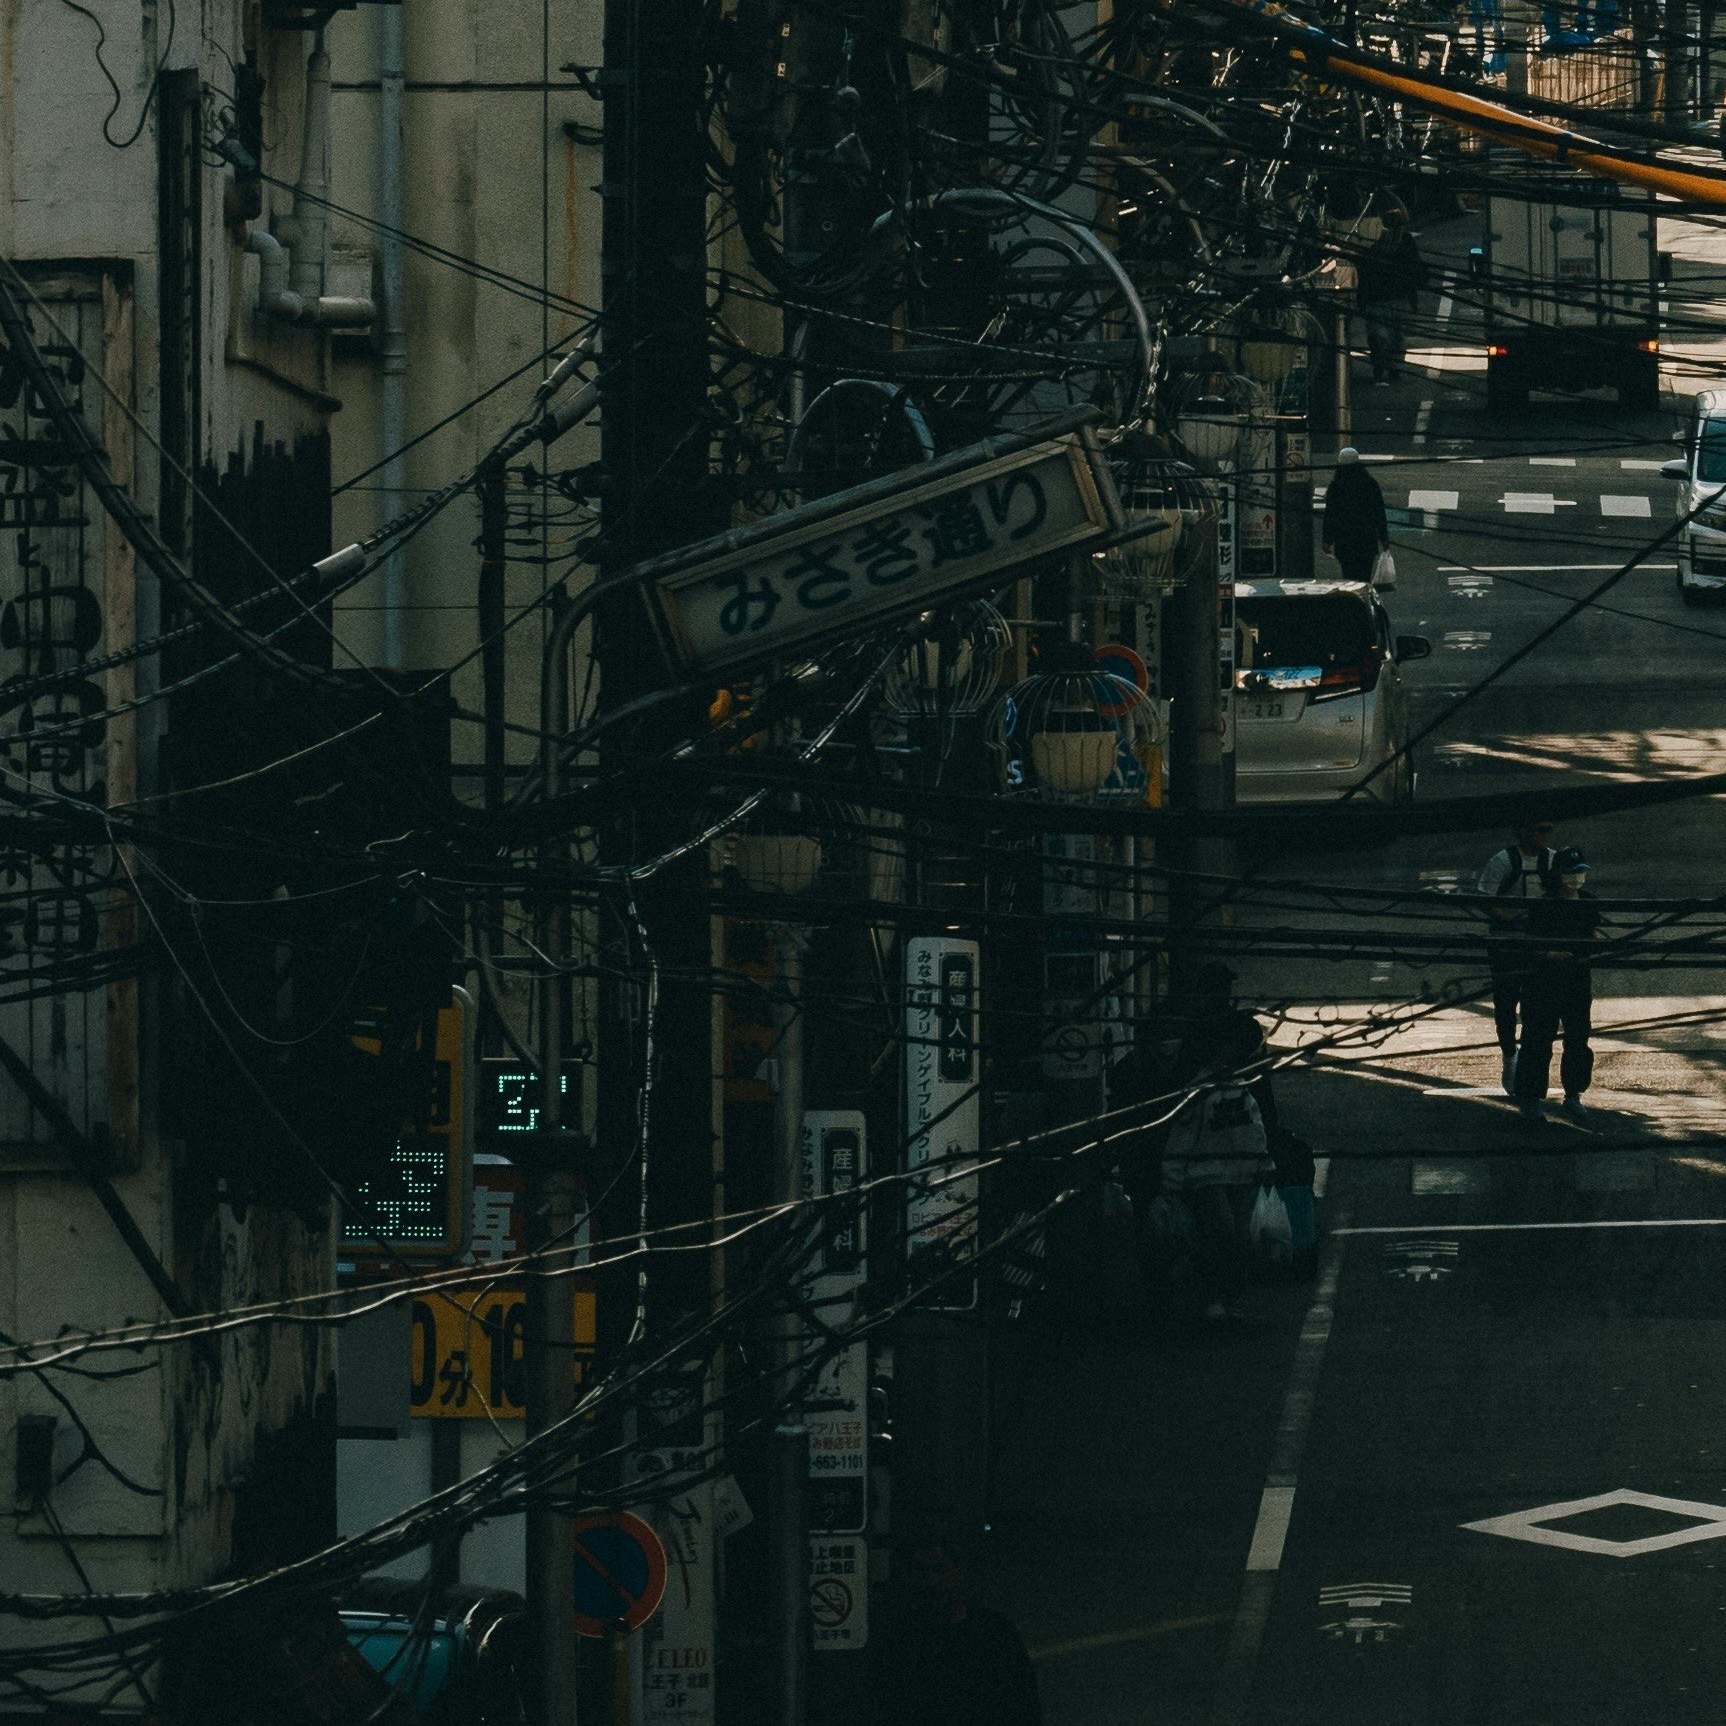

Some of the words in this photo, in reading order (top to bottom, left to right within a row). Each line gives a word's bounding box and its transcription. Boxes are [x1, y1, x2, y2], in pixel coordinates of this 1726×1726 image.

[719, 472, 1048, 635] みさき通り
[832, 1147, 853, 1253] 産科
[649, 1647, 707, 1670] ELEO
